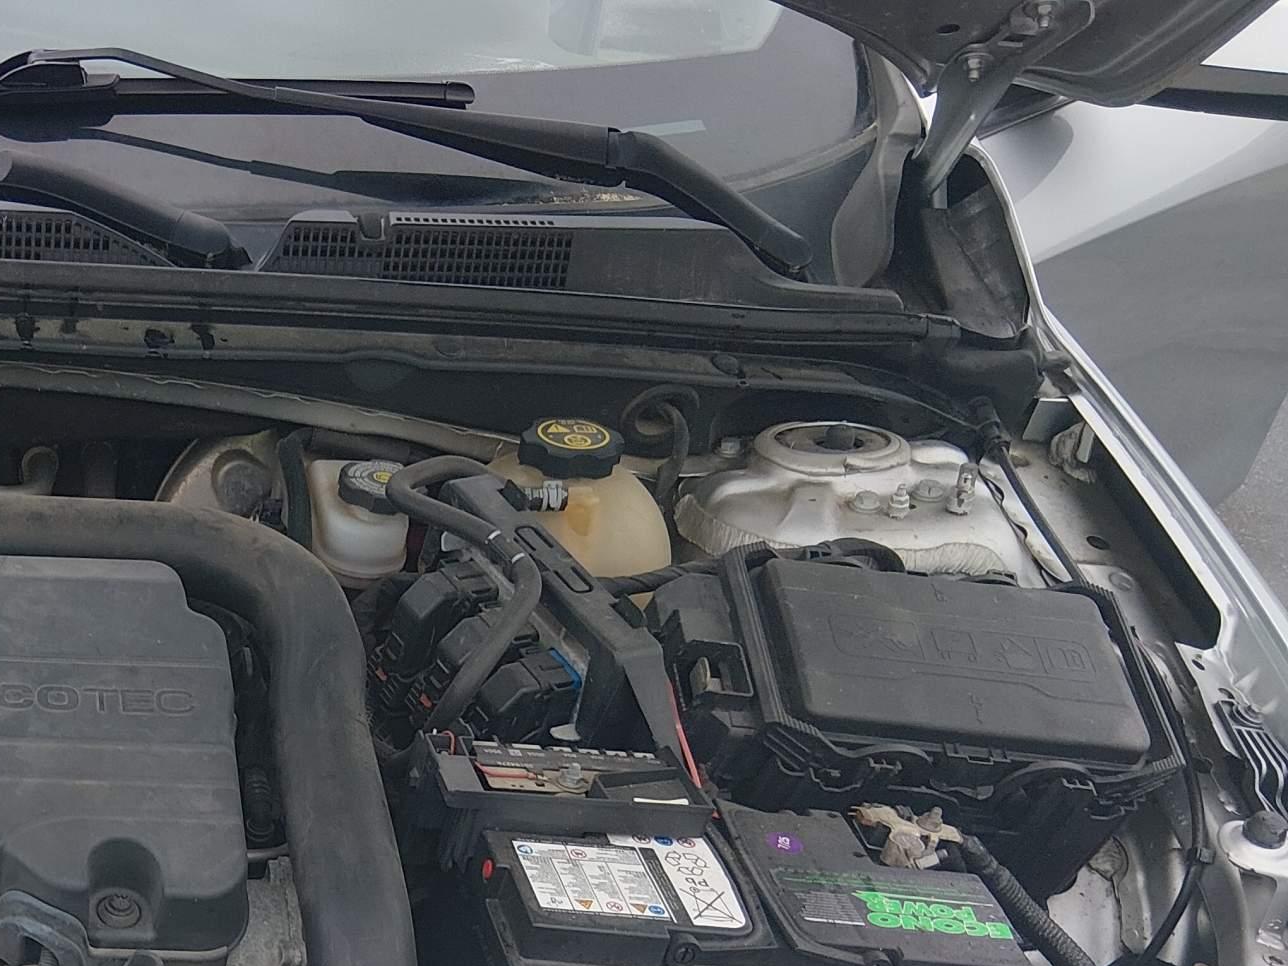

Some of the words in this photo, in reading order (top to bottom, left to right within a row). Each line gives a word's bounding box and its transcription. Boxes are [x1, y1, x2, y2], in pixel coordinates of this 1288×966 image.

[685, 877, 710, 888] Pb
[855, 891, 977, 922] POWER
[866, 912, 1014, 939] ECONO
